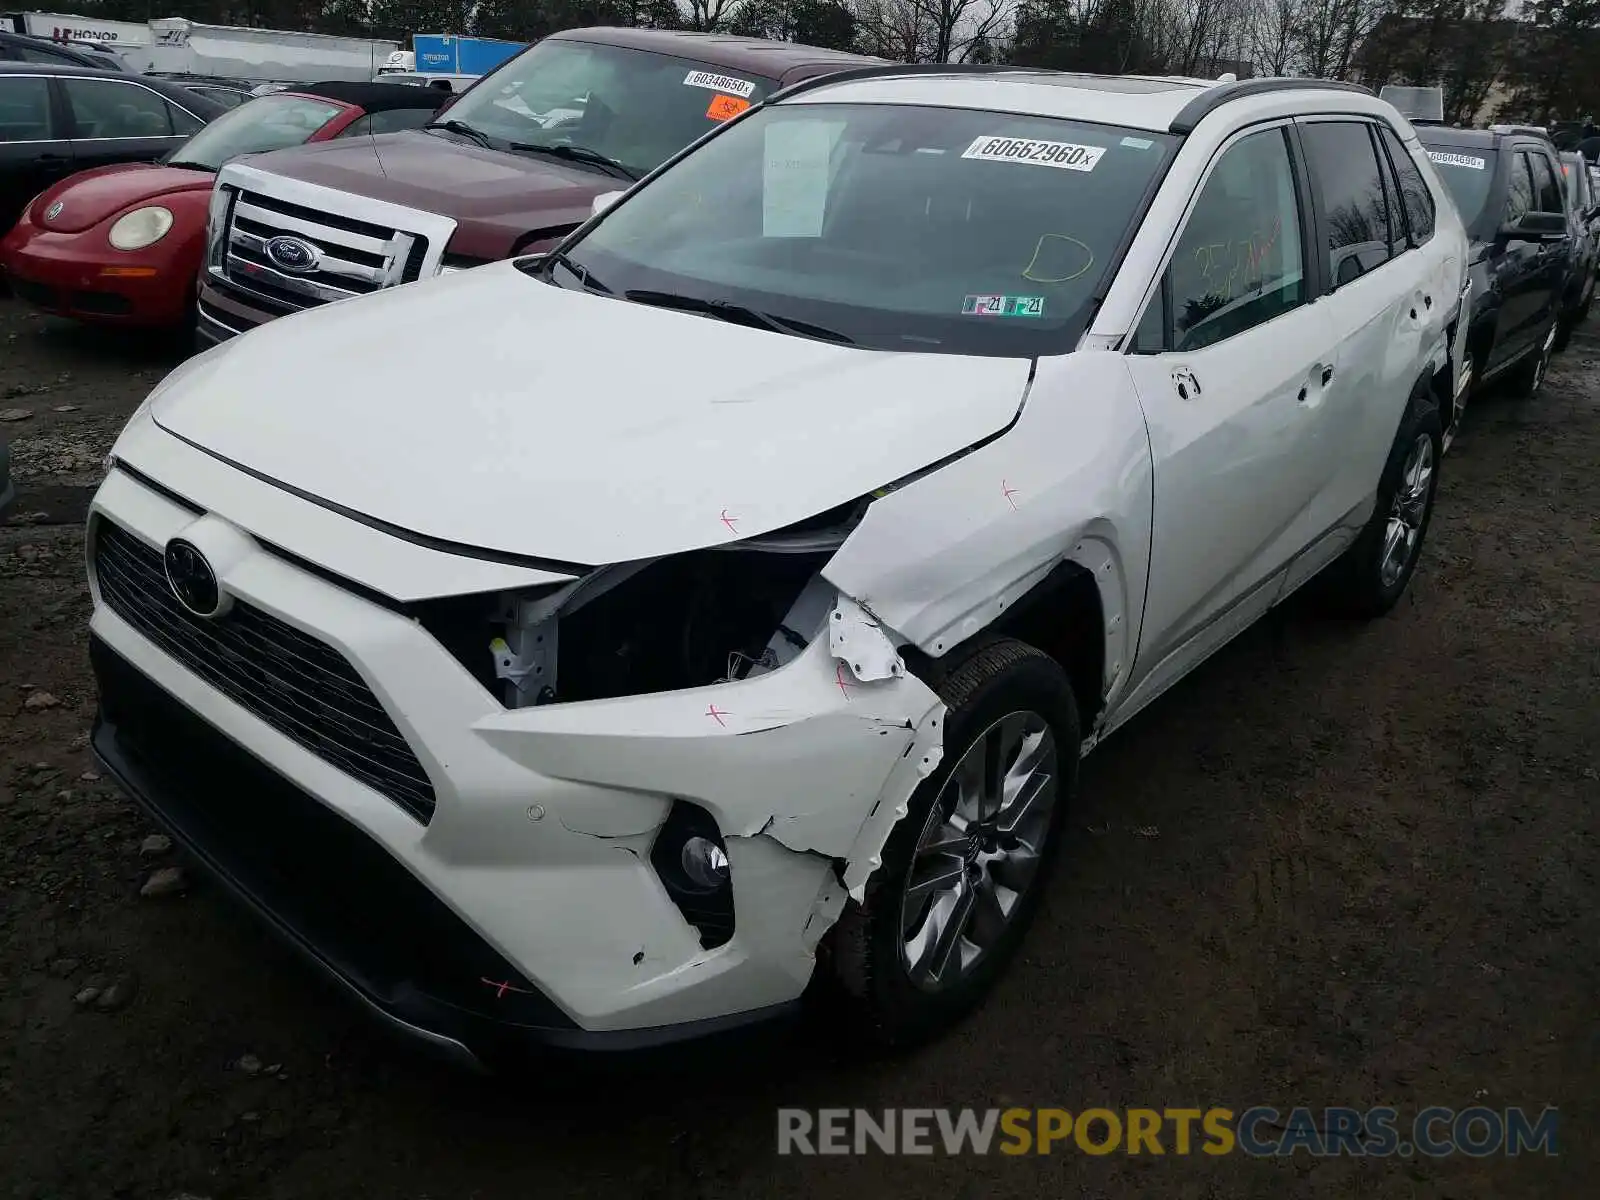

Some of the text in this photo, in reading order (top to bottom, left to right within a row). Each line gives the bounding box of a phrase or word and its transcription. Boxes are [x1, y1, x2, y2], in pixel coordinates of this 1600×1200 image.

[73, 30, 118, 41] HONOR
[423, 53, 450, 62] amazon
[981, 138, 1094, 165] 60662960x
[988, 297, 1001, 311] 21
[1028, 298, 1041, 313] 21
